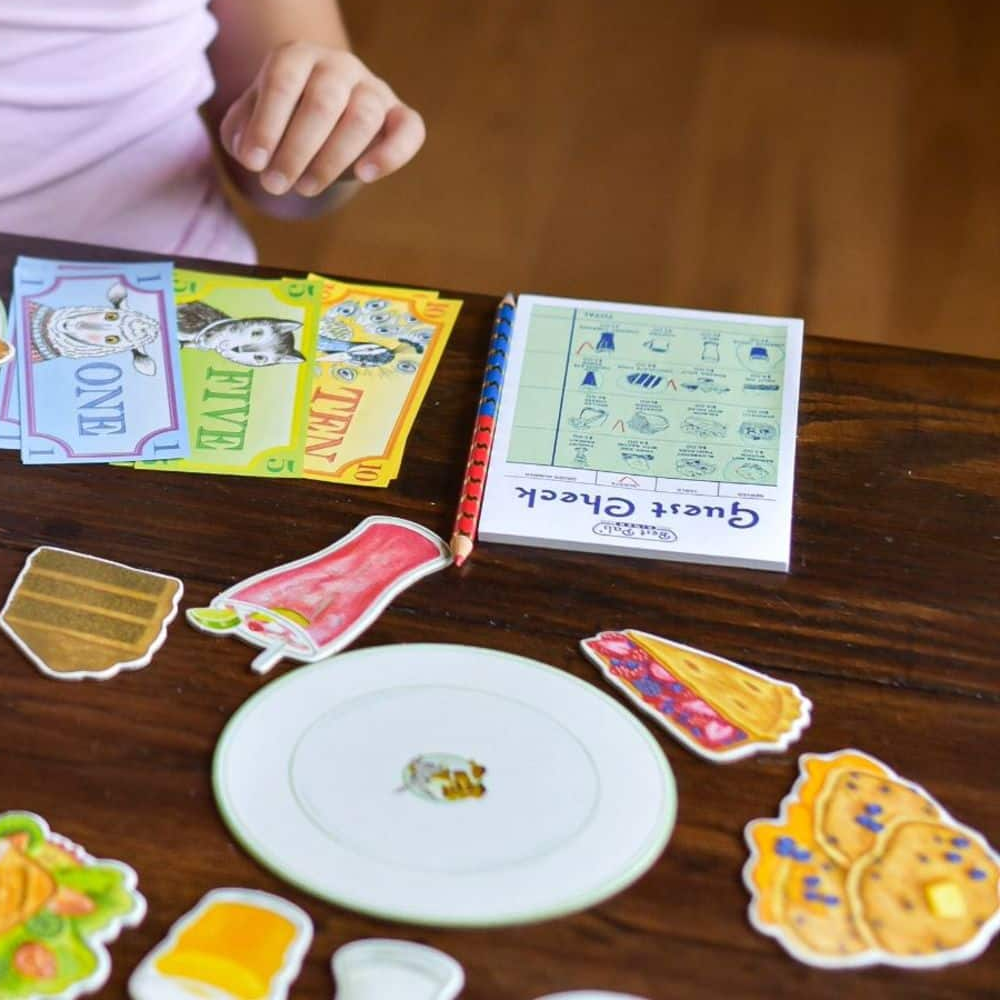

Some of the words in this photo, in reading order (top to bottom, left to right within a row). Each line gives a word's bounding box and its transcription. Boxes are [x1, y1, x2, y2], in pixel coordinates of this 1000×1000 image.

[136, 273, 162, 284] 1
[287, 283, 315, 298] 5
[424, 300, 450, 319] 10
[75, 361, 127, 436] ONE
[195, 365, 255, 451] FIVE
[304, 385, 365, 464] TEN
[28, 447, 55, 457] 1
[153, 439, 180, 456] 1
[266, 456, 296, 473] 5
[353, 463, 383, 483] 10
[515, 486, 636, 518] Check
[651, 501, 761, 530] Guest
[636, 528, 672, 540] Best
